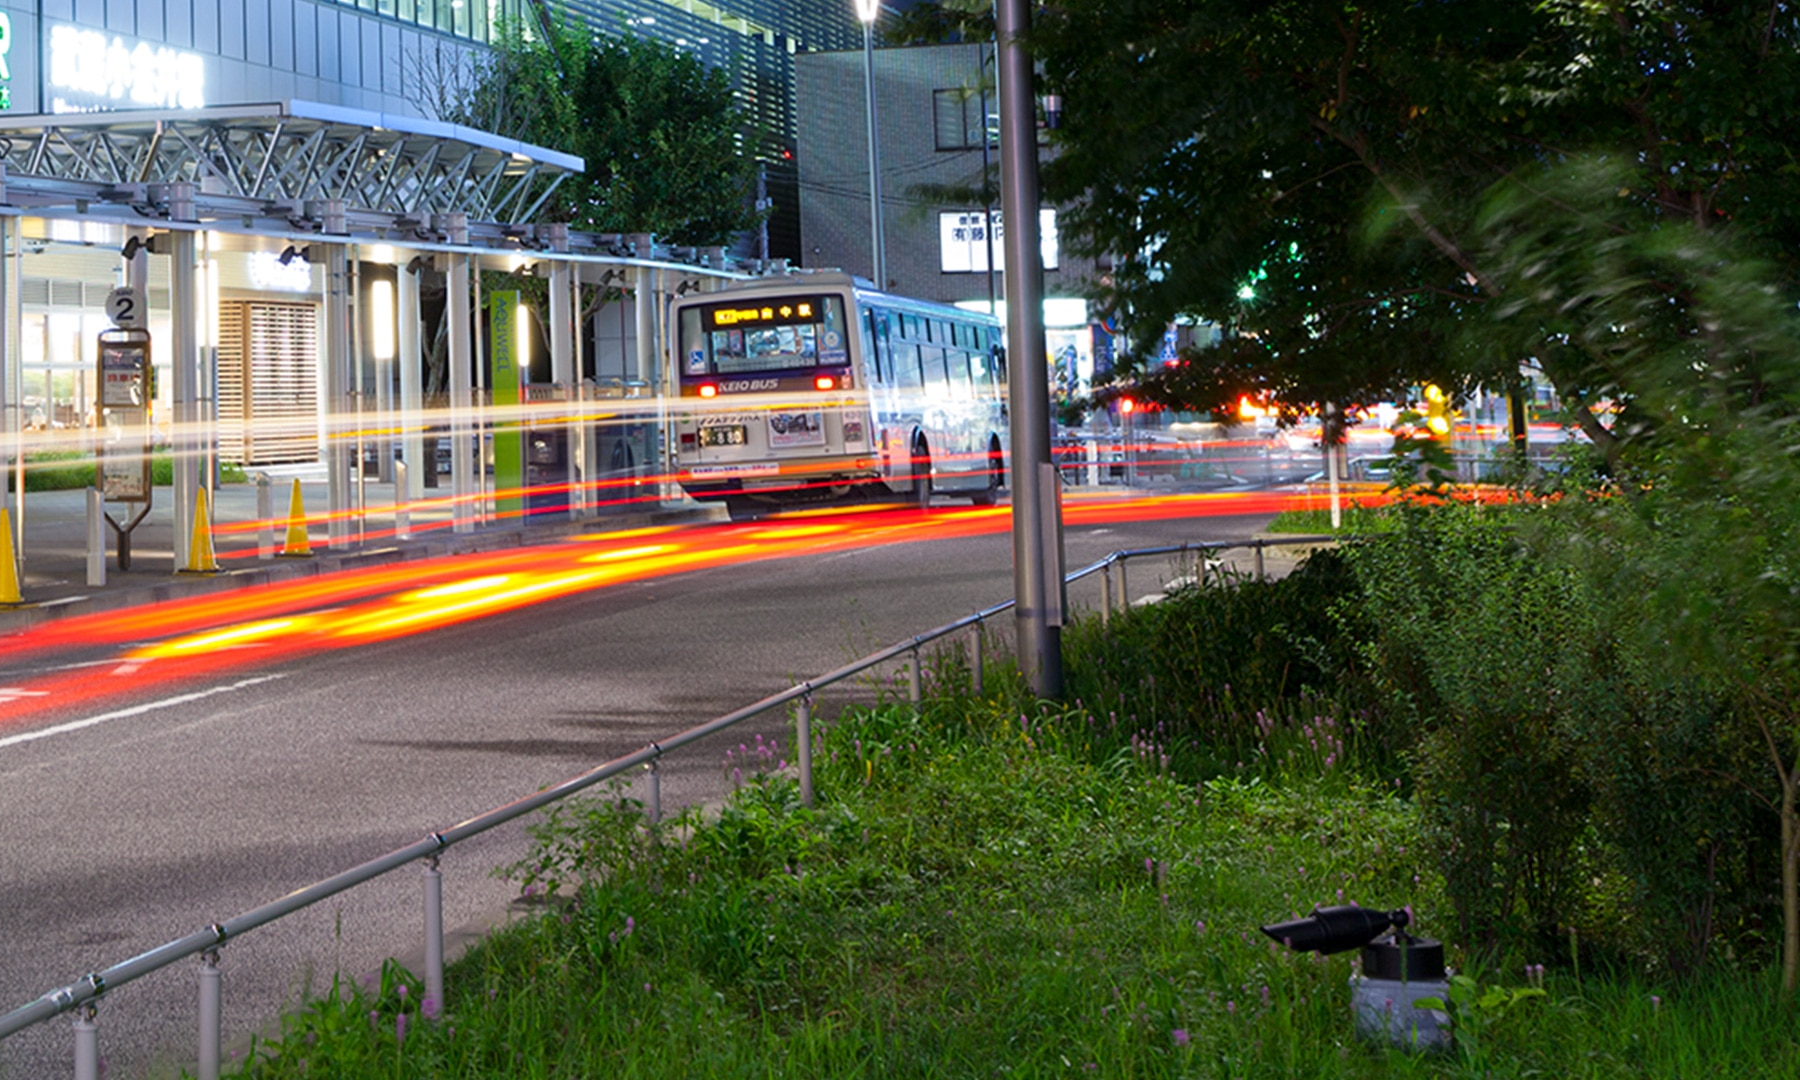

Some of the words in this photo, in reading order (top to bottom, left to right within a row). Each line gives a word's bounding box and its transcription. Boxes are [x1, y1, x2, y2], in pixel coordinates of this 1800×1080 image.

[116, 297, 134, 320] 2
[718, 380, 749, 392] KEIO
[750, 378, 779, 391] BUS
